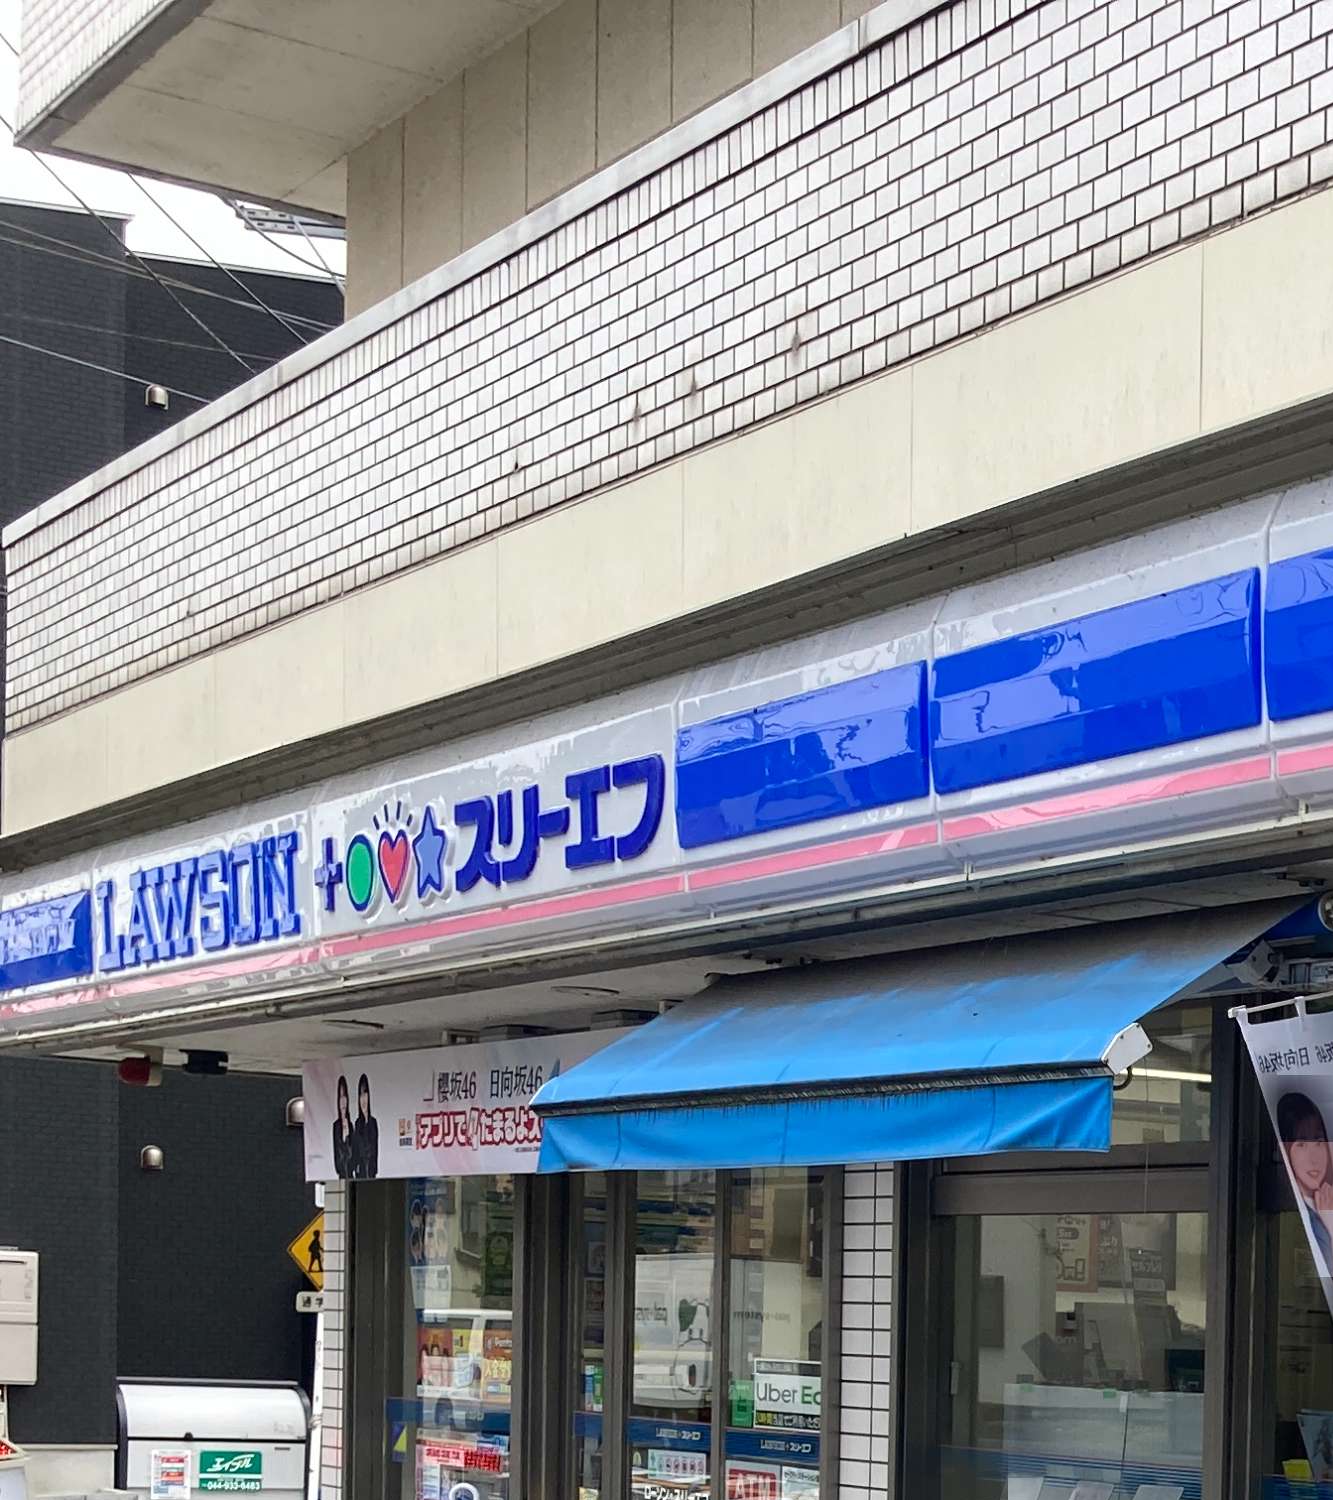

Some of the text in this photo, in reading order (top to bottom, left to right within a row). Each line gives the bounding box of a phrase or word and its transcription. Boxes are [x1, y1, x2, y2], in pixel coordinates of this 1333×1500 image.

[455, 754, 664, 893] スリーエフ
[95, 831, 301, 970] LAWSON
[756, 1382, 798, 1404] Uber
